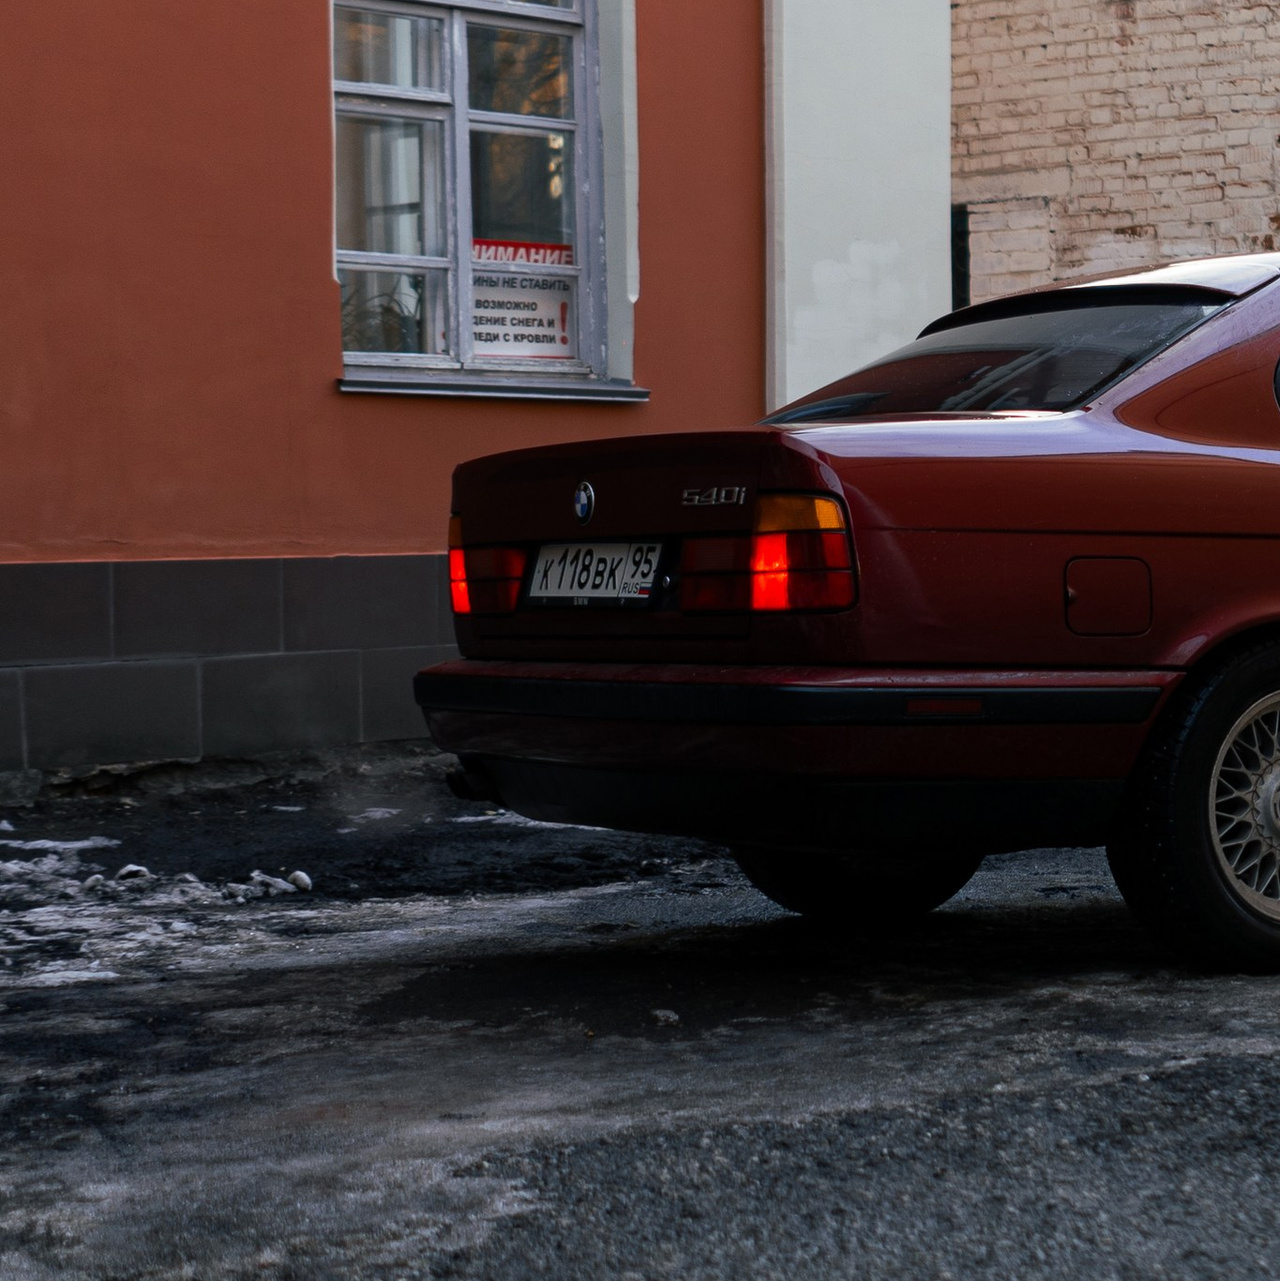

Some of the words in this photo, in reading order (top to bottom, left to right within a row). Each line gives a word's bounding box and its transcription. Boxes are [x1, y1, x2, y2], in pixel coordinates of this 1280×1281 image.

[502, 277, 518, 289] НЕ
[520, 278, 571, 292] СТАВИТЬ
[475, 299, 538, 312] ВОЗМОЖНО
[510, 317, 545, 328] СНЕГА
[547, 318, 556, 329] И
[503, 333, 511, 342] С
[513, 333, 557, 345] КРОВЛИ
[682, 486, 747, 506] 540i
[631, 545, 657, 579] 95
[622, 582, 640, 594] RUS
